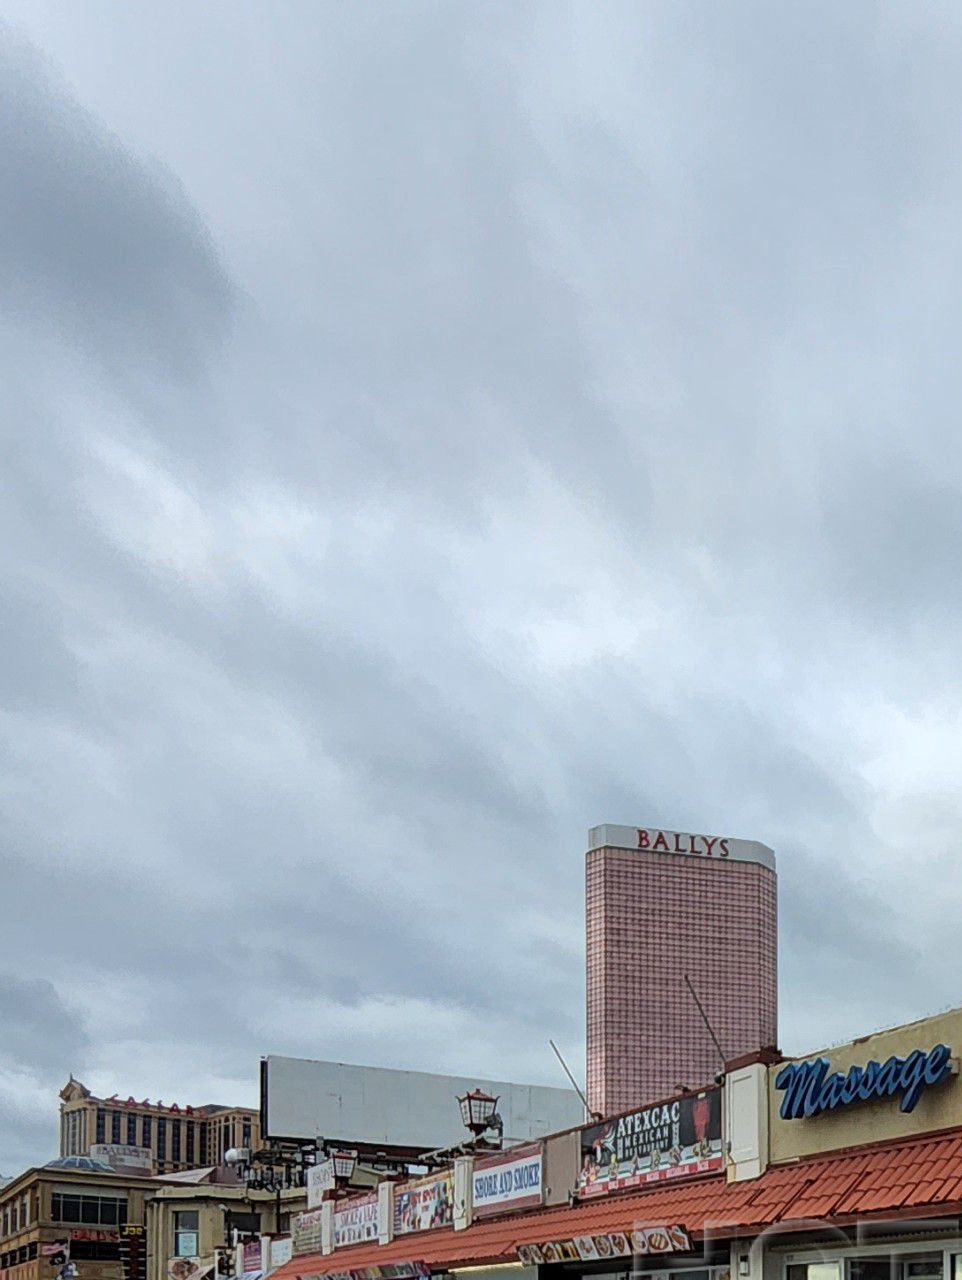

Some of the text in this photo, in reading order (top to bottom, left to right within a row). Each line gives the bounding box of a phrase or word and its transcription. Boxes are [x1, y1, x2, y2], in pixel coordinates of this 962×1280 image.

[775, 1043, 951, 1120] Massage
[624, 1126, 669, 1148] MEXICAN
[498, 1170, 513, 1195] AND
[513, 1162, 540, 1190] SMOKE
